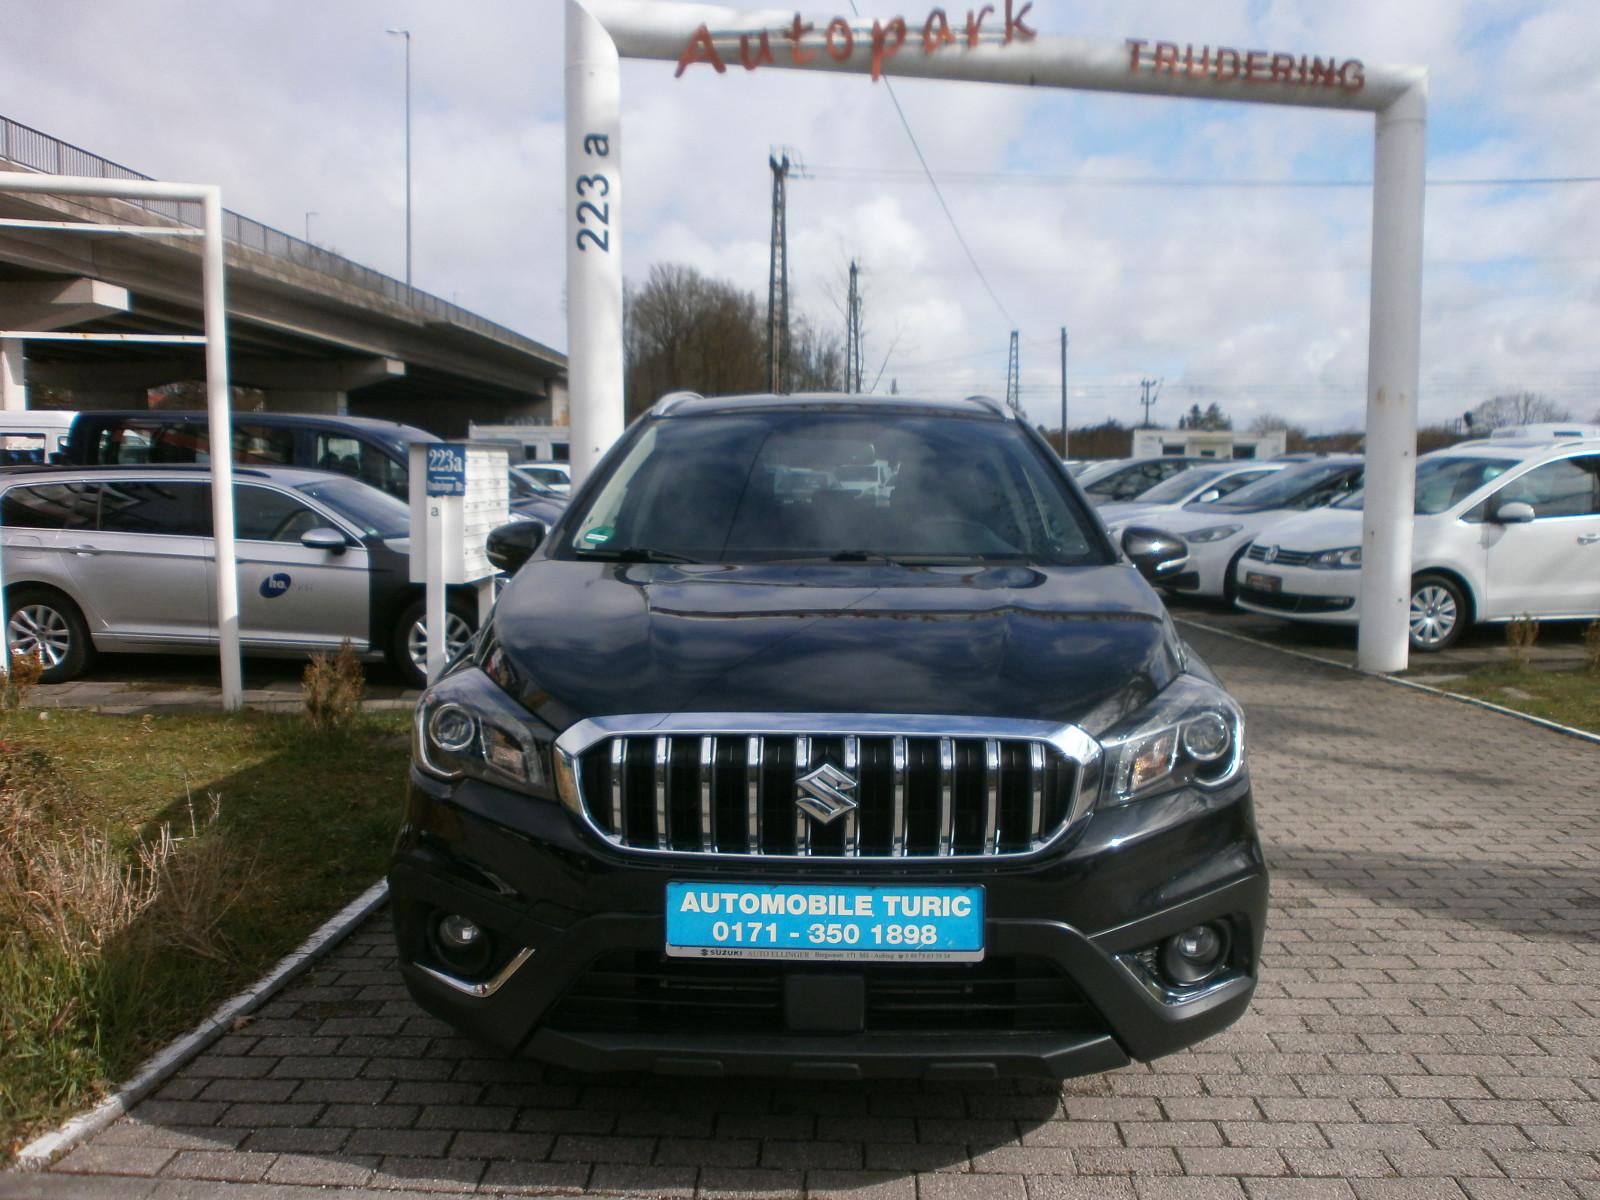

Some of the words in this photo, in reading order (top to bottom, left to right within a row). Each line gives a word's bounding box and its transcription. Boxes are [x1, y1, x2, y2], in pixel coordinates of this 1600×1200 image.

[675, 1, 1037, 82] Autopark
[1125, 38, 1366, 92] TRUDERING
[583, 132, 610, 157] a
[576, 173, 610, 253] 223
[428, 449, 464, 472] 223a
[680, 891, 874, 917] AUTOMOBILE
[883, 895, 972, 917] TURIC
[712, 921, 778, 942] 0171
[807, 923, 860, 944] 350
[870, 924, 938, 945] 1898
[710, 949, 743, 957] SUZUKI
